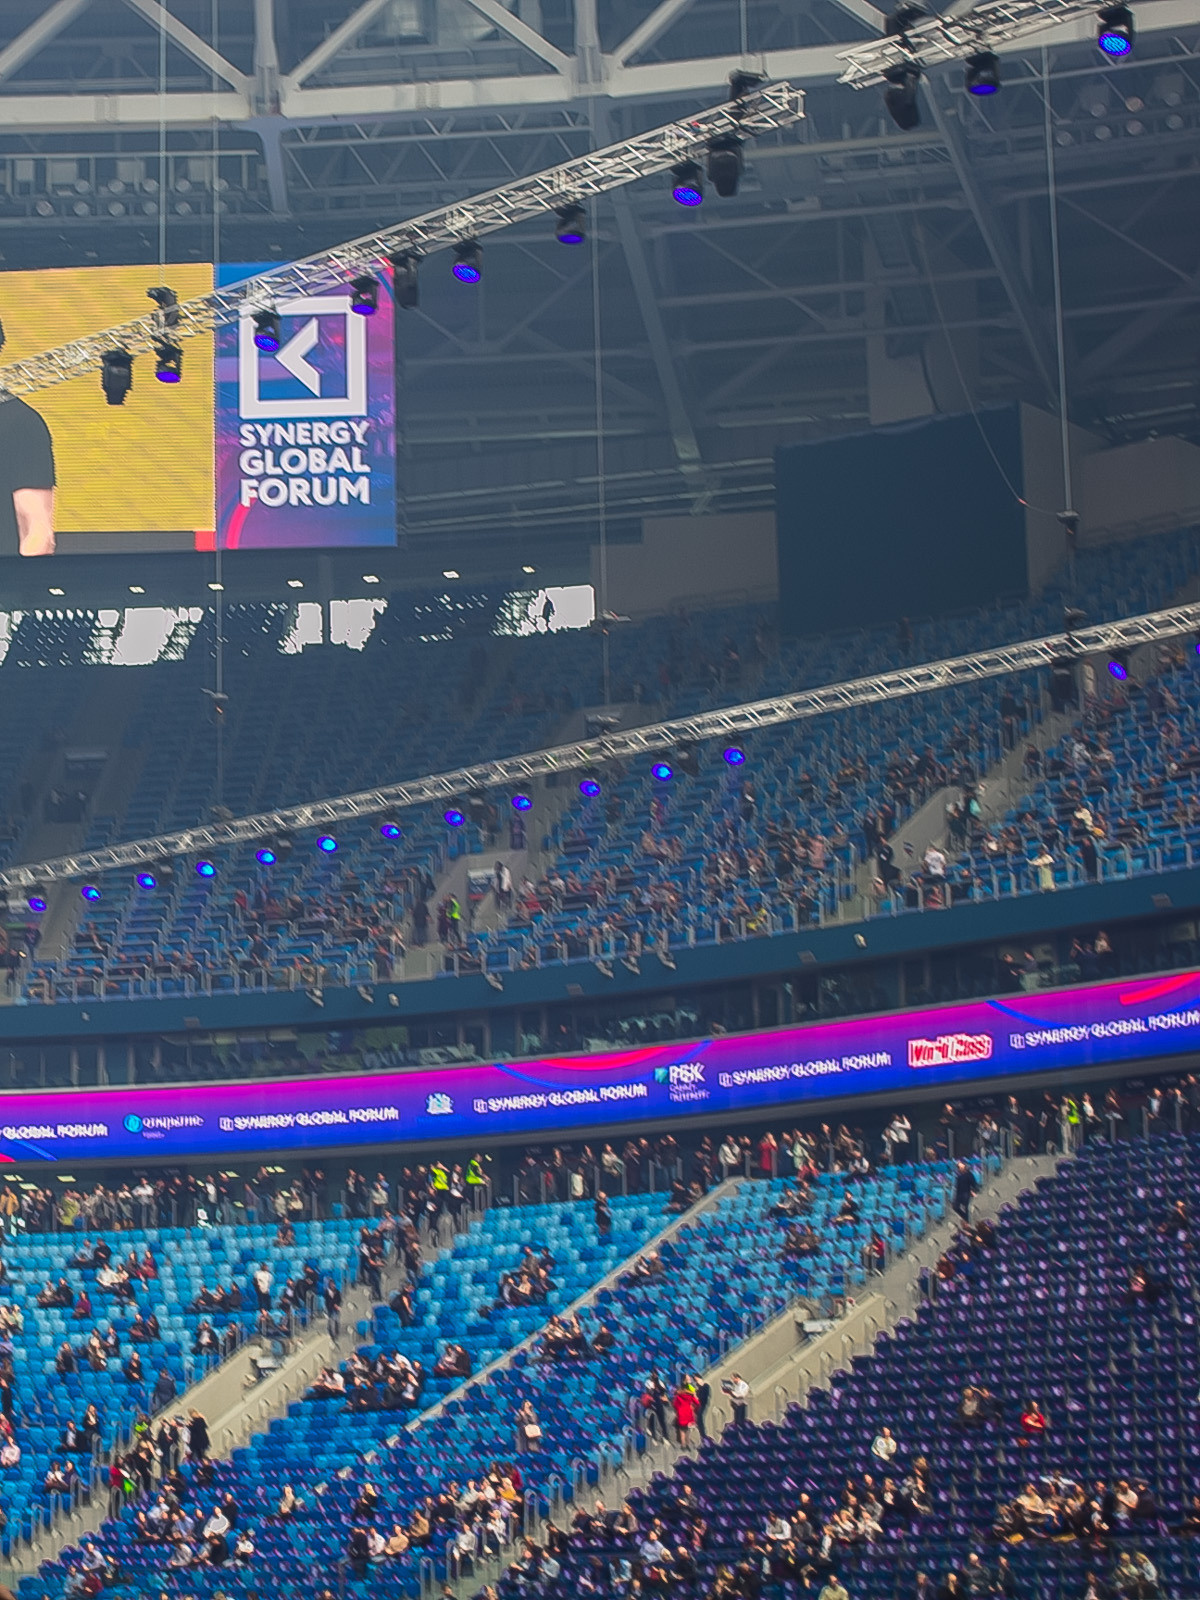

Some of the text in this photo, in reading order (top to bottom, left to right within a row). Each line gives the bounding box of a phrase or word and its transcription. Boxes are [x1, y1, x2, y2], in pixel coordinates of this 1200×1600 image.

[239, 420, 370, 447] SYNERGY
[239, 446, 371, 476] GLOBAL
[240, 476, 370, 507] FORUM
